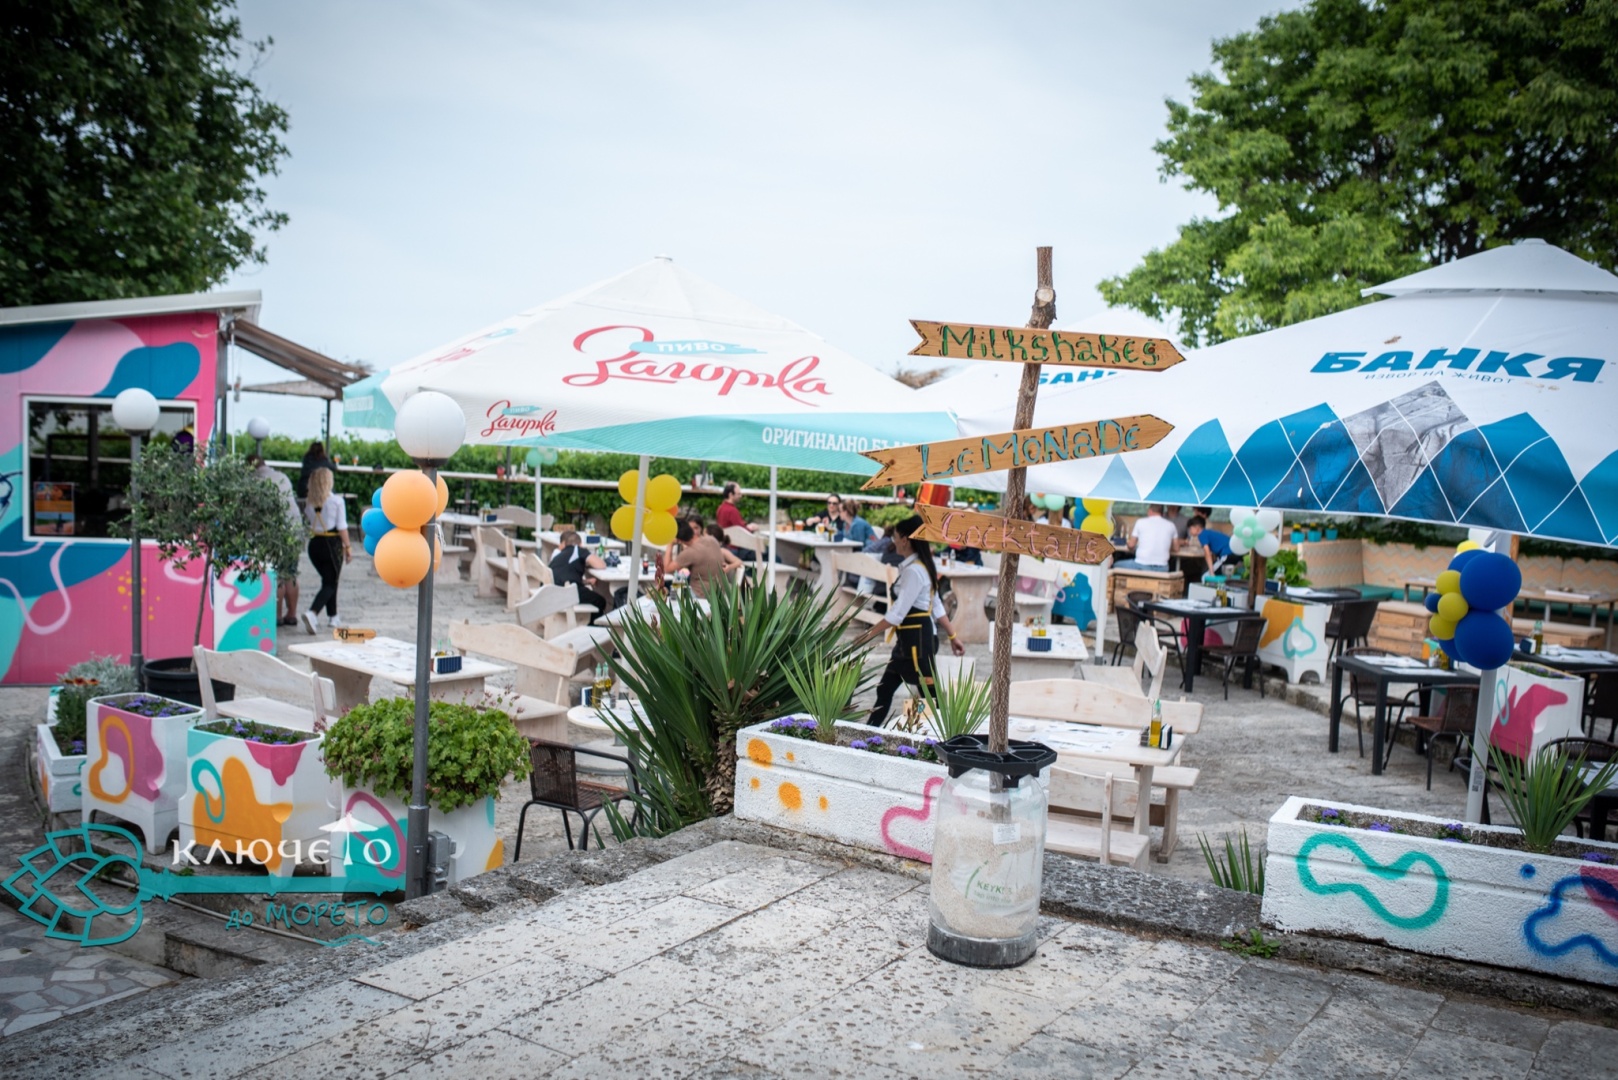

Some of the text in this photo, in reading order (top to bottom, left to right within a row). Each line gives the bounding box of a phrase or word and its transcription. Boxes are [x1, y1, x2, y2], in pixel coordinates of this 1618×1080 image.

[656, 341, 727, 353] ПИВО
[562, 326, 834, 406] Загорка
[1038, 369, 1117, 386] АН
[1309, 347, 1606, 384] БАНКЯ
[1365, 371, 1417, 380] ИЗВОР
[1451, 371, 1515, 385] ЖИВОТ
[480, 399, 557, 438] Загорка
[761, 426, 868, 453] ОРИГИНАЛНО
[941, 511, 1100, 563] Cocktails
